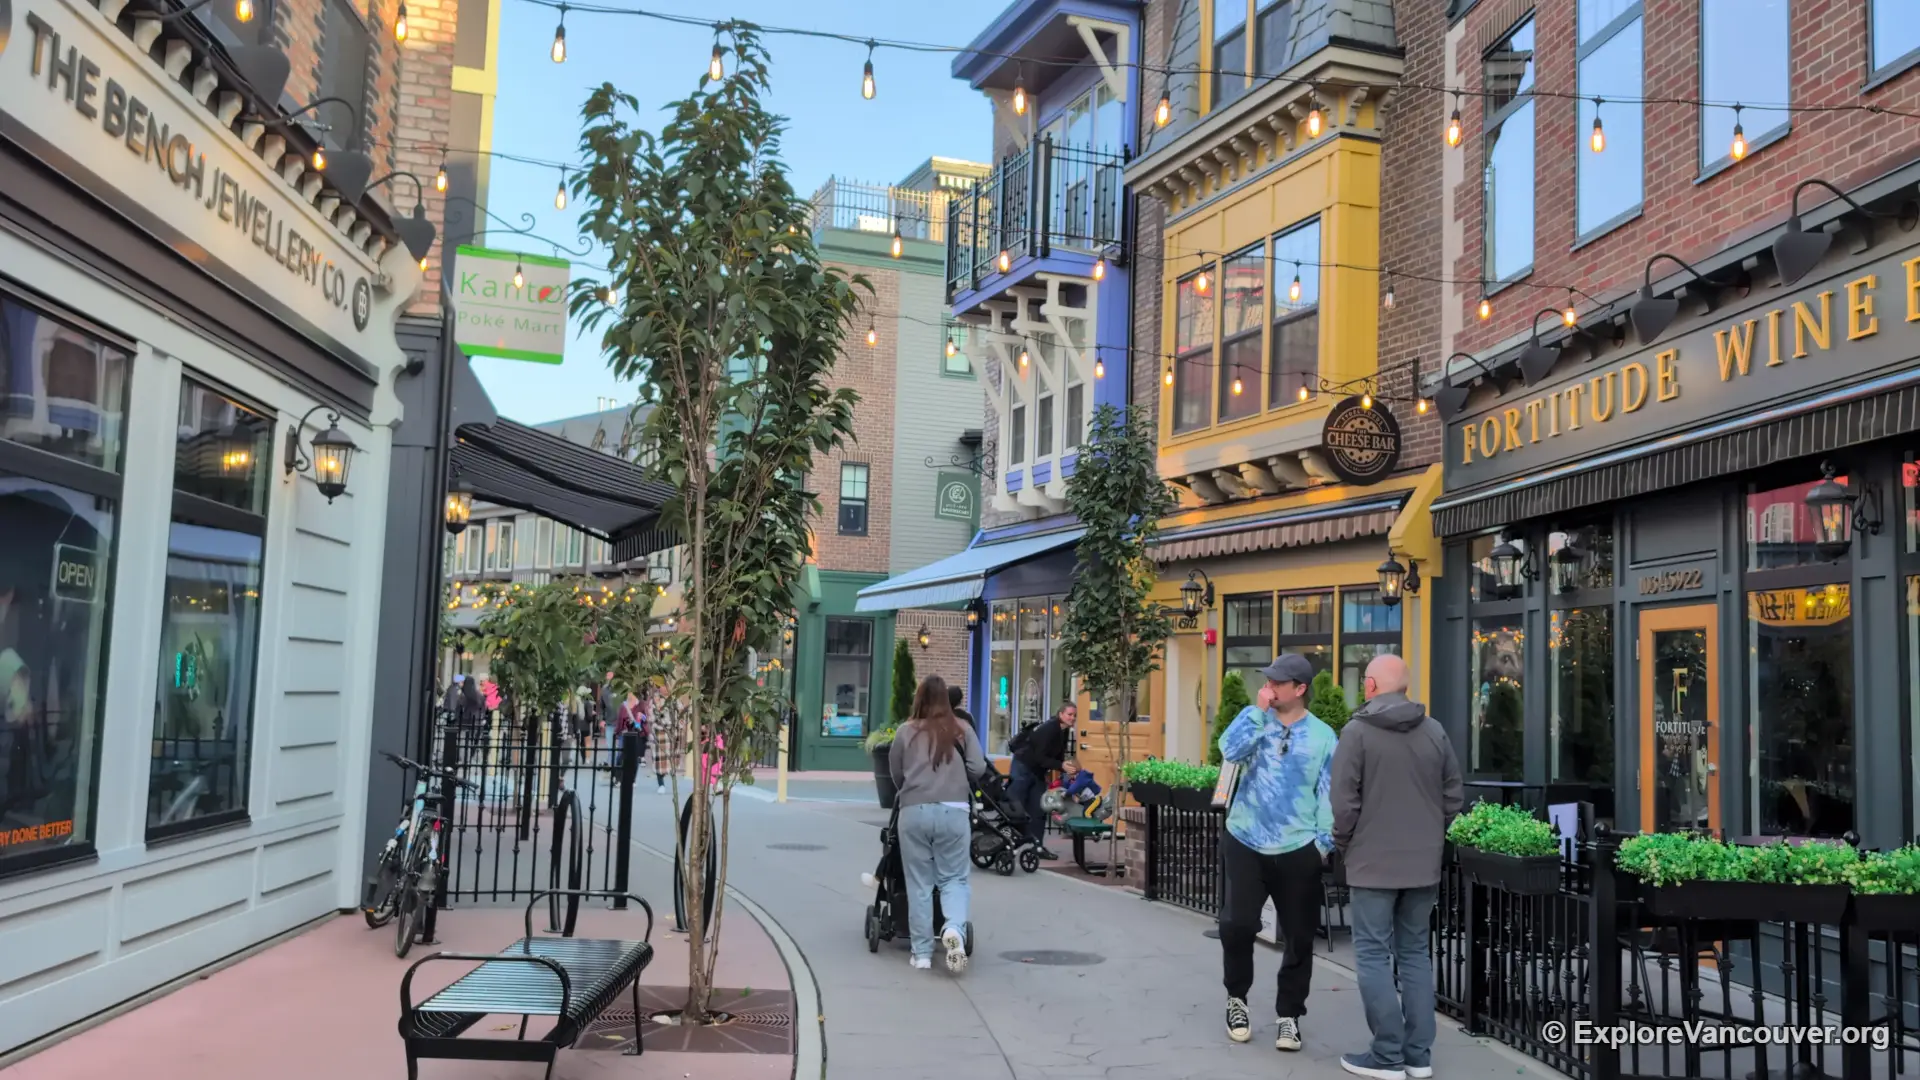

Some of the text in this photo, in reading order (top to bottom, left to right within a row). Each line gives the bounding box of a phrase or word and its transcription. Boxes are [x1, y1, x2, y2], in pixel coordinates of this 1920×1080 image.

[26, 10, 348, 313] THE BENCH JEWELLERY CO.
[458, 310, 560, 336] Poké Mart
[1462, 347, 1680, 465] FORTITUDE
[1712, 274, 1879, 382] WINE
[1327, 432, 1396, 450] CHEESE BAR
[59, 560, 94, 588] OPEN
[12, 827, 38, 845] DONE
[40, 820, 72, 840] BETTER
